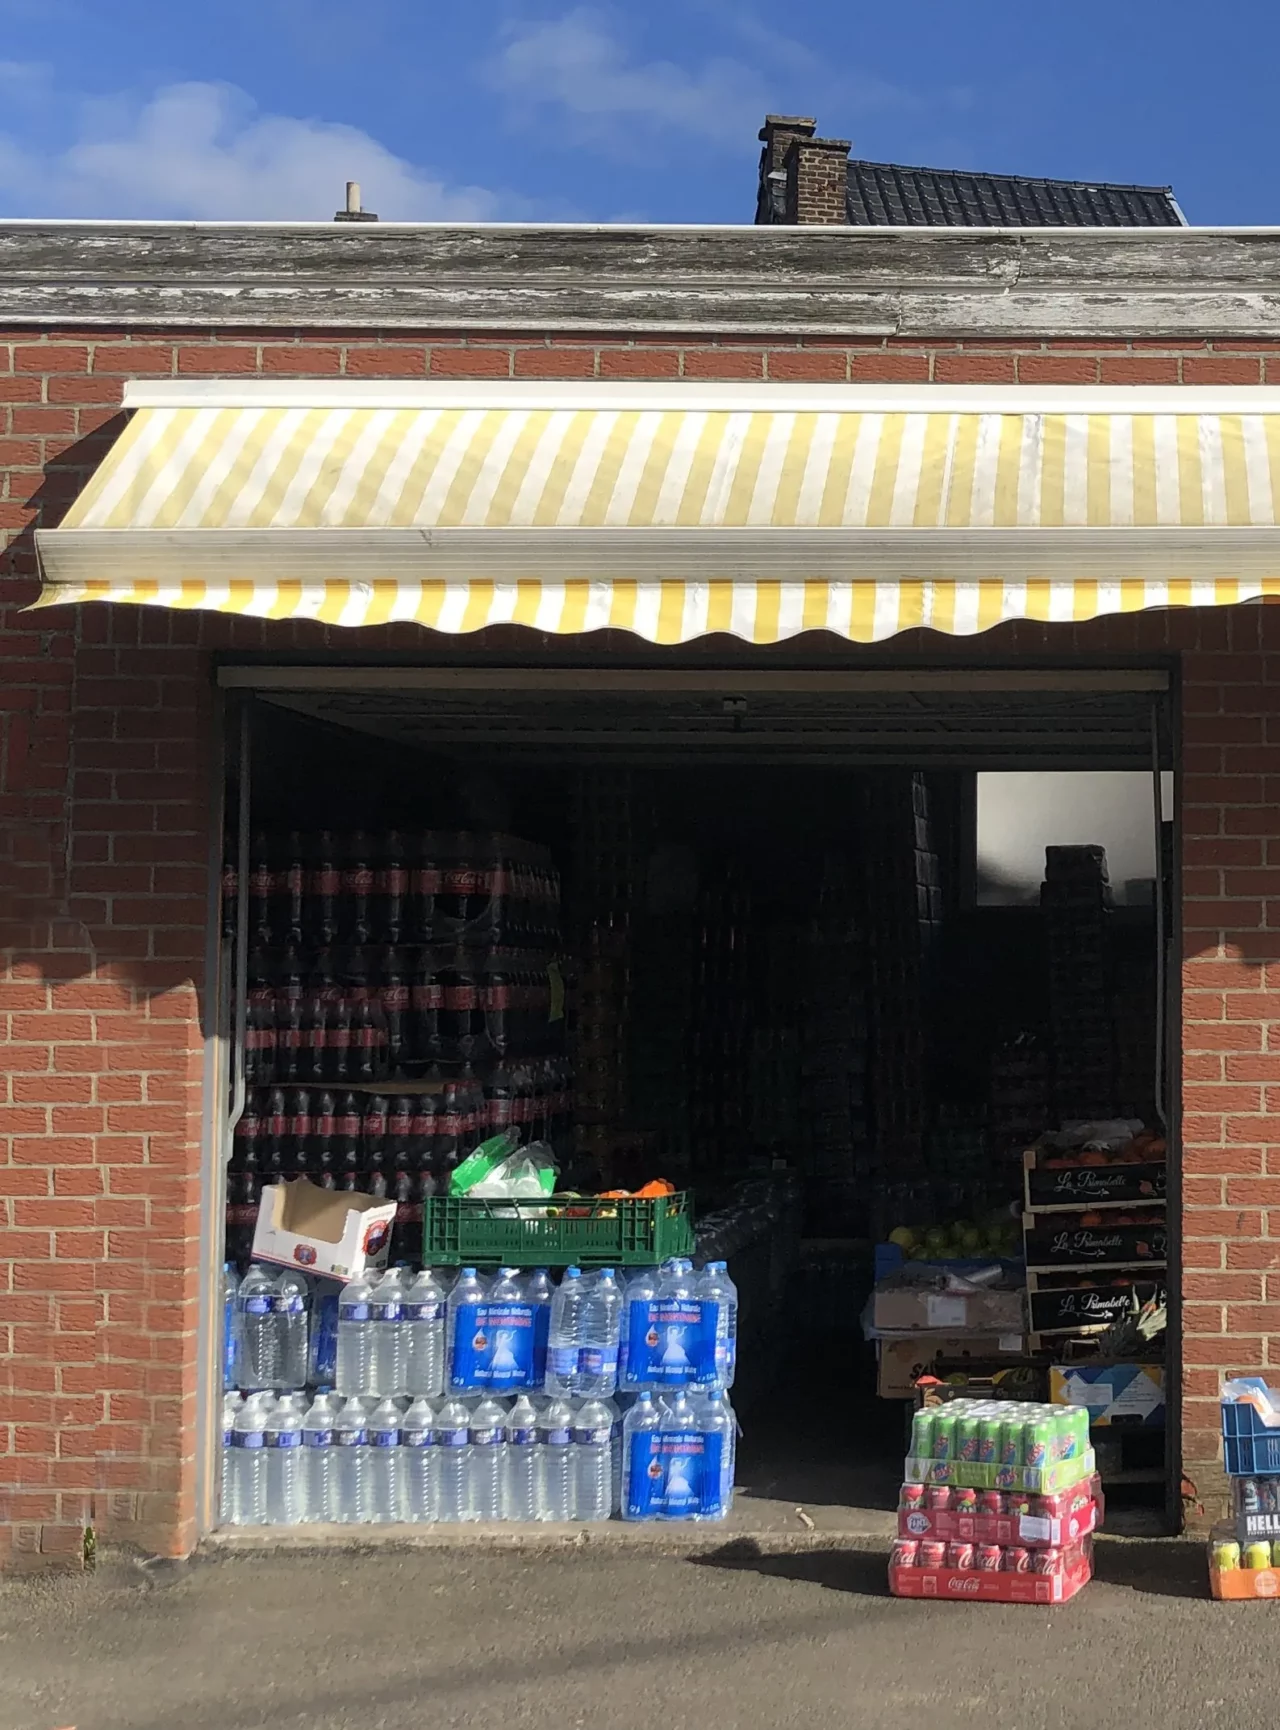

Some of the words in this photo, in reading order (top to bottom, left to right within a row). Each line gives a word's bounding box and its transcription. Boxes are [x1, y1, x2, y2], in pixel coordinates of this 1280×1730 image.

[1053, 1171, 1072, 1192] La
[1050, 1231, 1068, 1252] La
[1057, 1294, 1076, 1316] La
[1246, 1514, 1280, 1531] HELL
